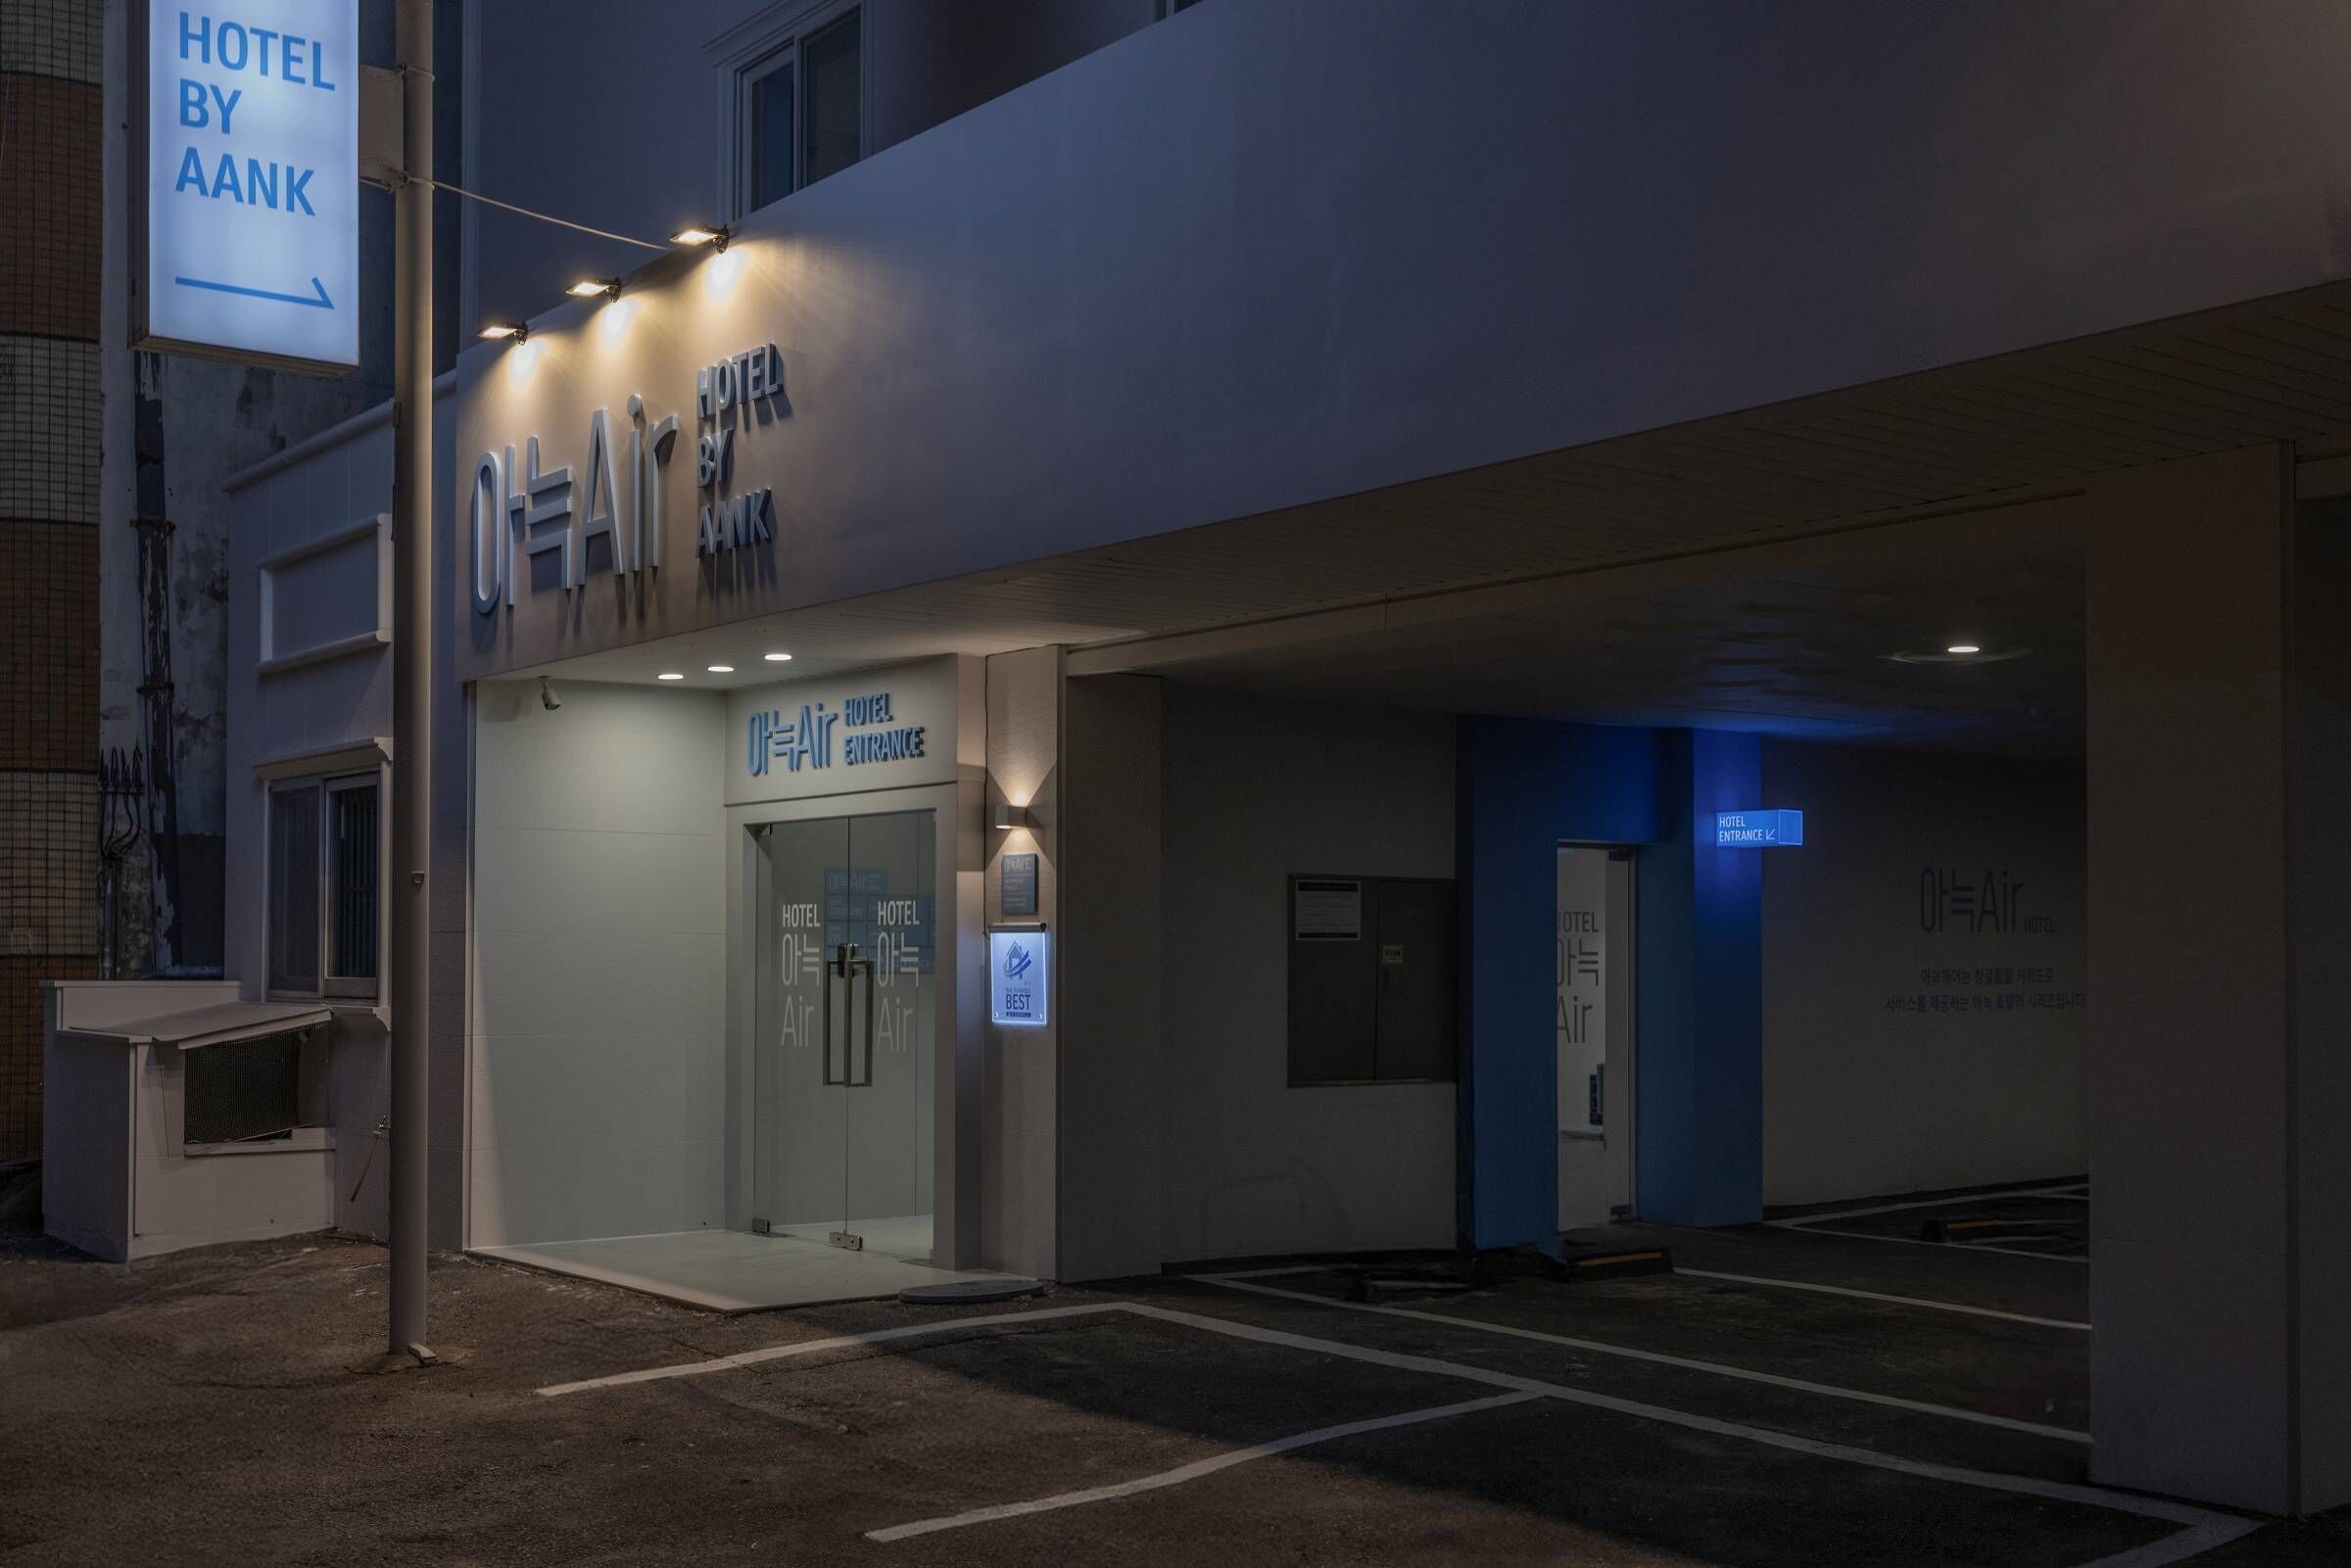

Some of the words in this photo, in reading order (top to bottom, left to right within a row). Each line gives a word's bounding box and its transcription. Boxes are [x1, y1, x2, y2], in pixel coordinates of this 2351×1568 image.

[177, 11, 336, 92] HOTEL
[178, 78, 243, 135] BY
[175, 146, 315, 216] AANK
[697, 343, 784, 419] HOTEL
[697, 428, 732, 488] BY
[696, 488, 772, 558] AANK
[843, 692, 893, 728] HOTEL
[843, 727, 925, 766] ENTRANCE
[1719, 815, 1746, 828] HOTEL
[1719, 829, 1763, 842] ENTRANCE
[783, 904, 821, 928] HOTEL
[878, 900, 920, 926] HOTEL
[2024, 916, 2055, 933] HOTEL
[783, 931, 821, 986] 아늑
[877, 931, 920, 988] 아늑
[782, 995, 815, 1048] Air
[878, 994, 914, 1053] Air
[1006, 994, 1032, 1011] BEST
[1557, 995, 1593, 1043] Air
